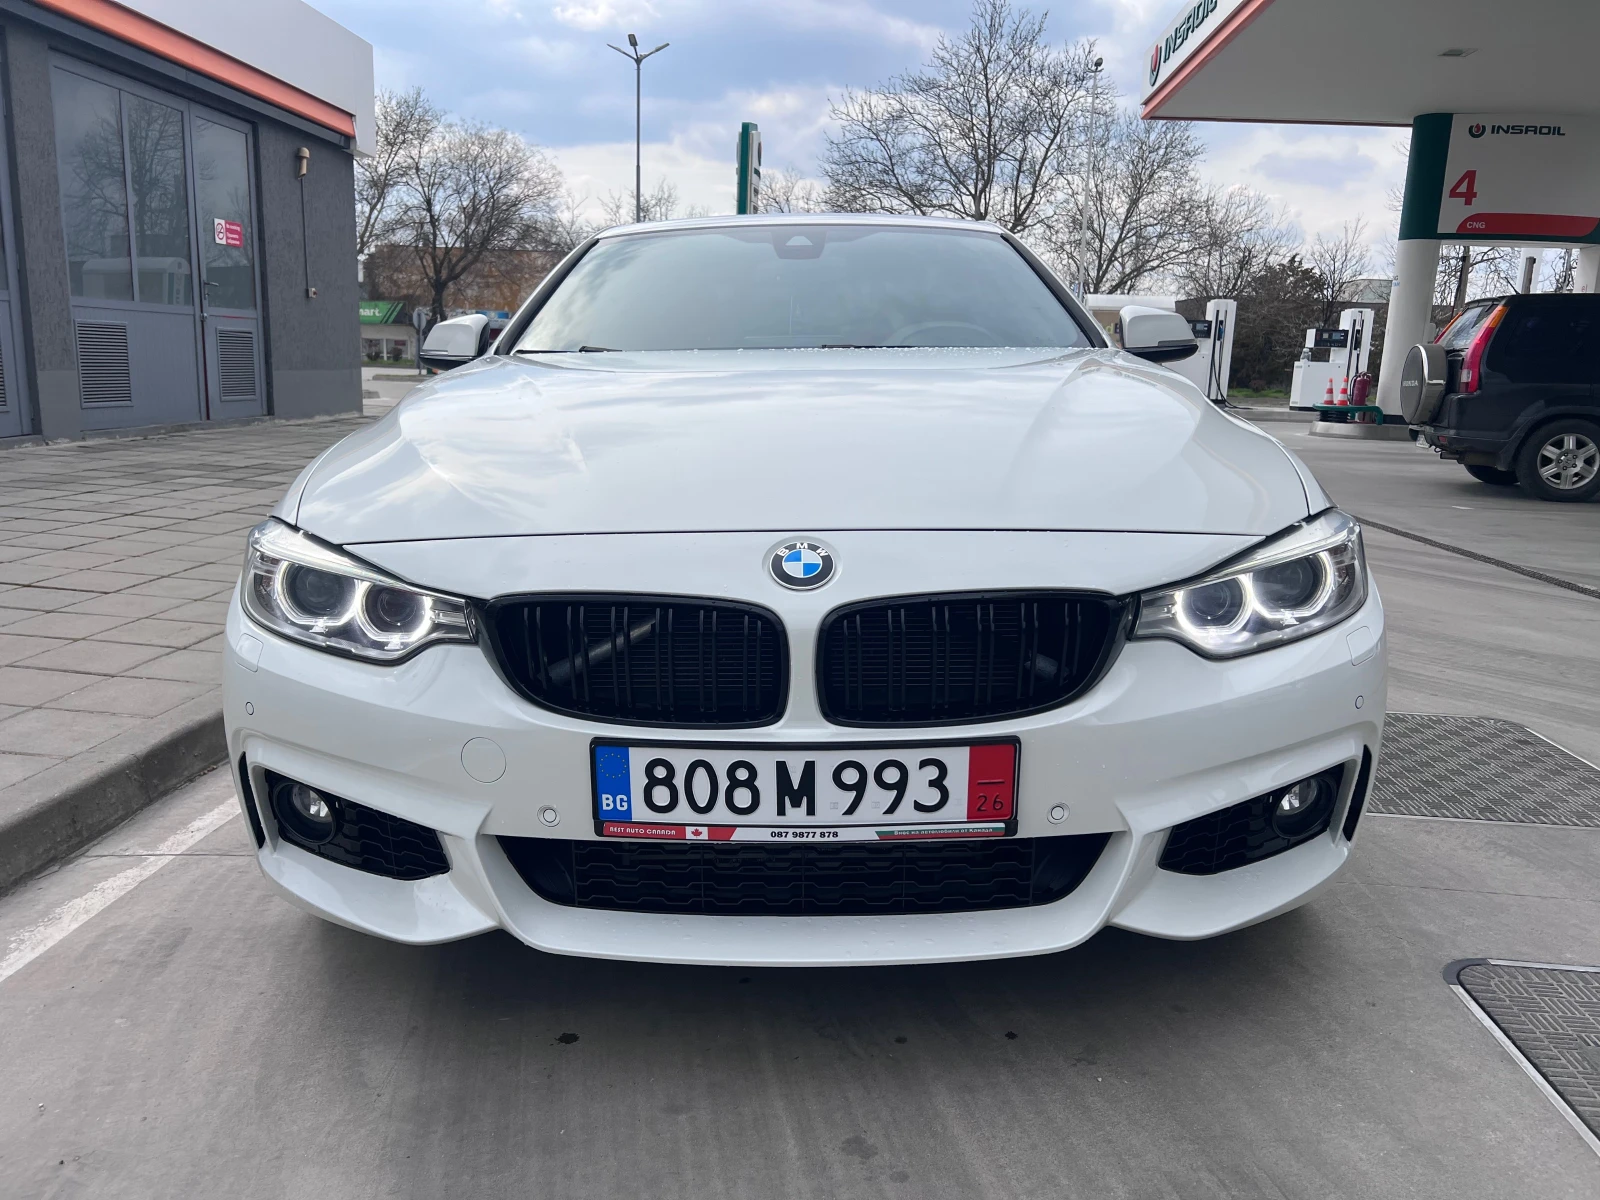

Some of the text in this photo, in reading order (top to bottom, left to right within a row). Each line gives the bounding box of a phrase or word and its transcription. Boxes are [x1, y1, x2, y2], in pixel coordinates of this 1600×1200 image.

[1490, 124, 1566, 136] INSAOIL
[1448, 169, 1478, 206] 4
[1466, 221, 1486, 229] CNG
[776, 542, 829, 557] BMW
[643, 757, 950, 817] 808 M 993
[601, 793, 628, 811] BG
[976, 793, 1005, 812] 26
